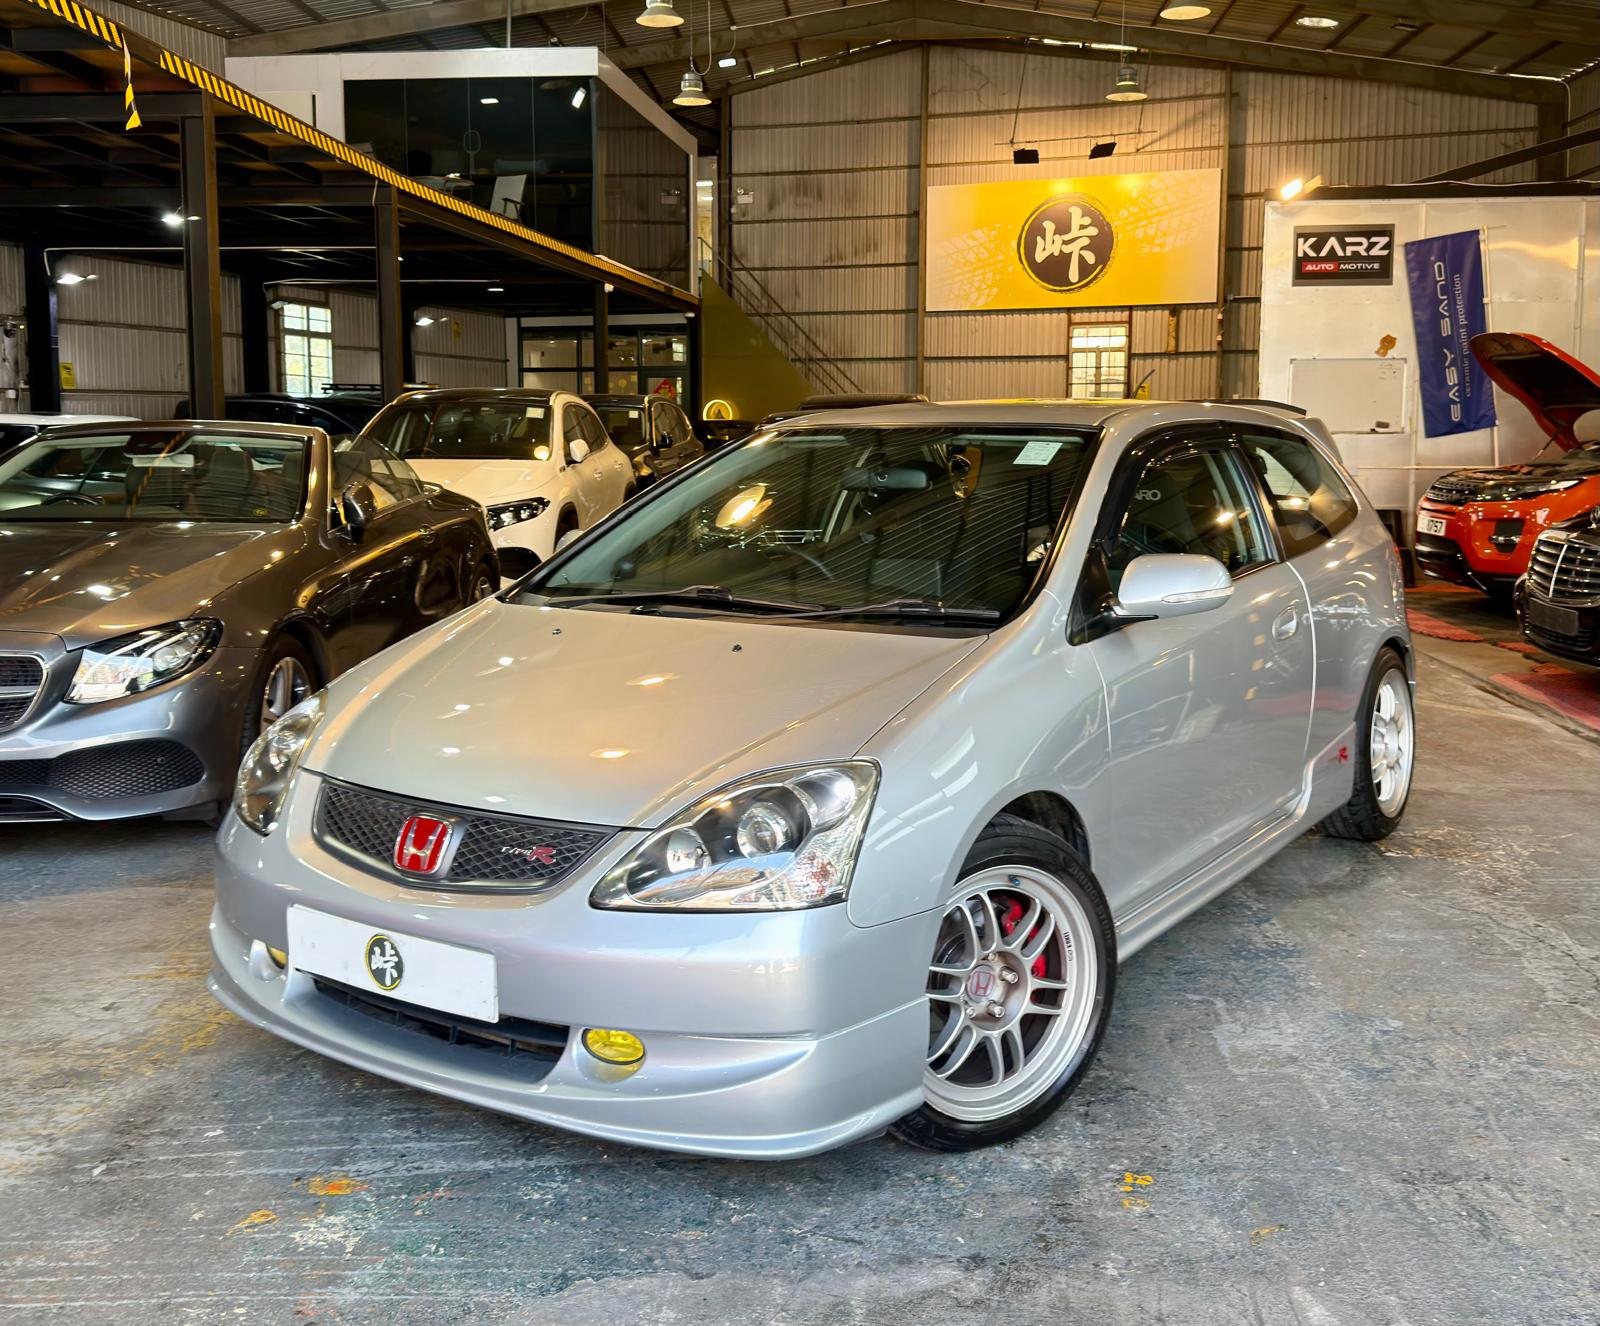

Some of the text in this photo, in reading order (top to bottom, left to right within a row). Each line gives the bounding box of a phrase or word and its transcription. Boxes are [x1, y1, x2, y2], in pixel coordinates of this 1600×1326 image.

[1034, 205, 1099, 283] 峠
[1297, 236, 1391, 257] KARZ
[1305, 263, 1334, 271] AUTO
[1434, 262, 1461, 421] EASY SAND
[1453, 274, 1471, 397] ceramic paint protection
[371, 941, 398, 986] 峠
